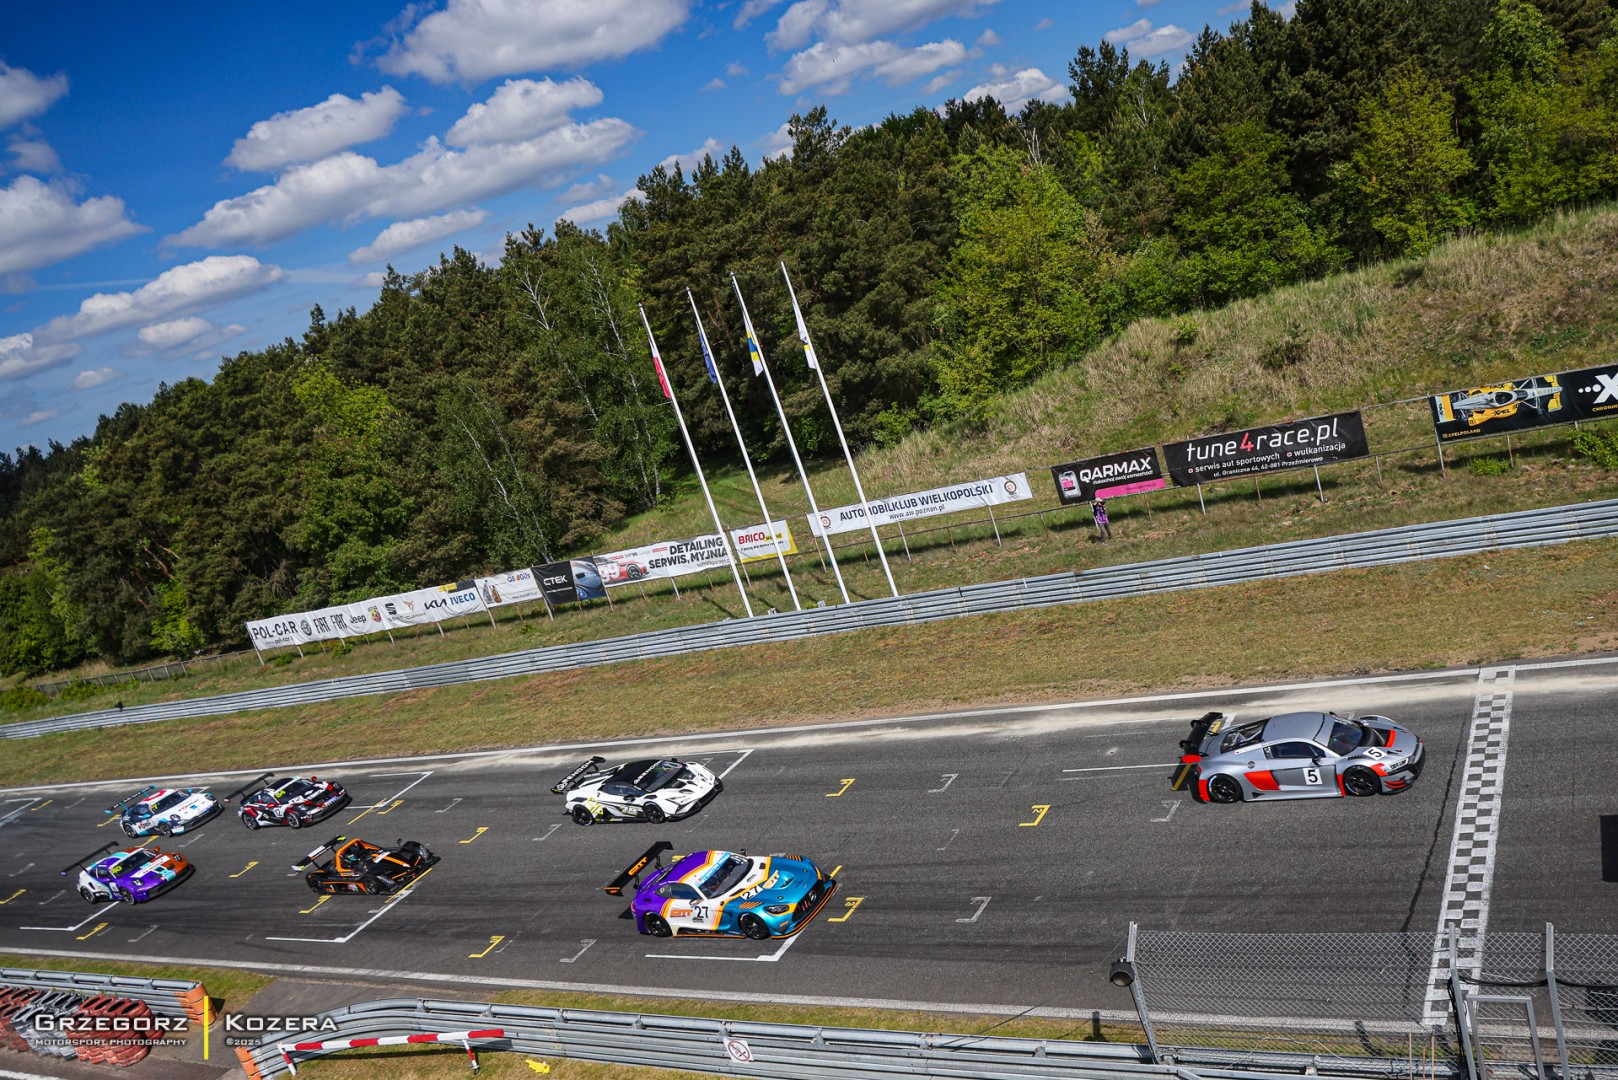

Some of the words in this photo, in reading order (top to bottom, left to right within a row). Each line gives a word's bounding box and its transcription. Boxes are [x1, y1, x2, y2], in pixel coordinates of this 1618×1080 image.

[1186, 417, 1338, 462] tune4race.pl
[1195, 463, 1220, 473] serwis
[1222, 460, 1234, 468] aut
[1236, 452, 1280, 467] sportowych
[1294, 440, 1346, 457] wulkanizacja
[1079, 456, 1152, 483] QARMAX
[1222, 467, 1250, 476] Graniczna
[918, 484, 994, 506] WIELKOPOLSKI
[889, 503, 946, 519] www.aw.poznan.pl
[669, 536, 724, 555] DETAILING
[648, 554, 690, 569] SERWIS,
[690, 547, 728, 562] MYJNIA
[543, 574, 568, 586] CTEK
[424, 598, 448, 610] KIA
[450, 592, 476, 606] IVECO
[313, 617, 331, 634] FIAT
[330, 614, 348, 631] FIAT
[349, 614, 367, 624] Jeep
[252, 620, 298, 640] POL-CAR
[1367, 748, 1382, 760] 5
[1307, 768, 1318, 784] 5
[742, 886, 760, 900] 27
[694, 905, 708, 919] 27
